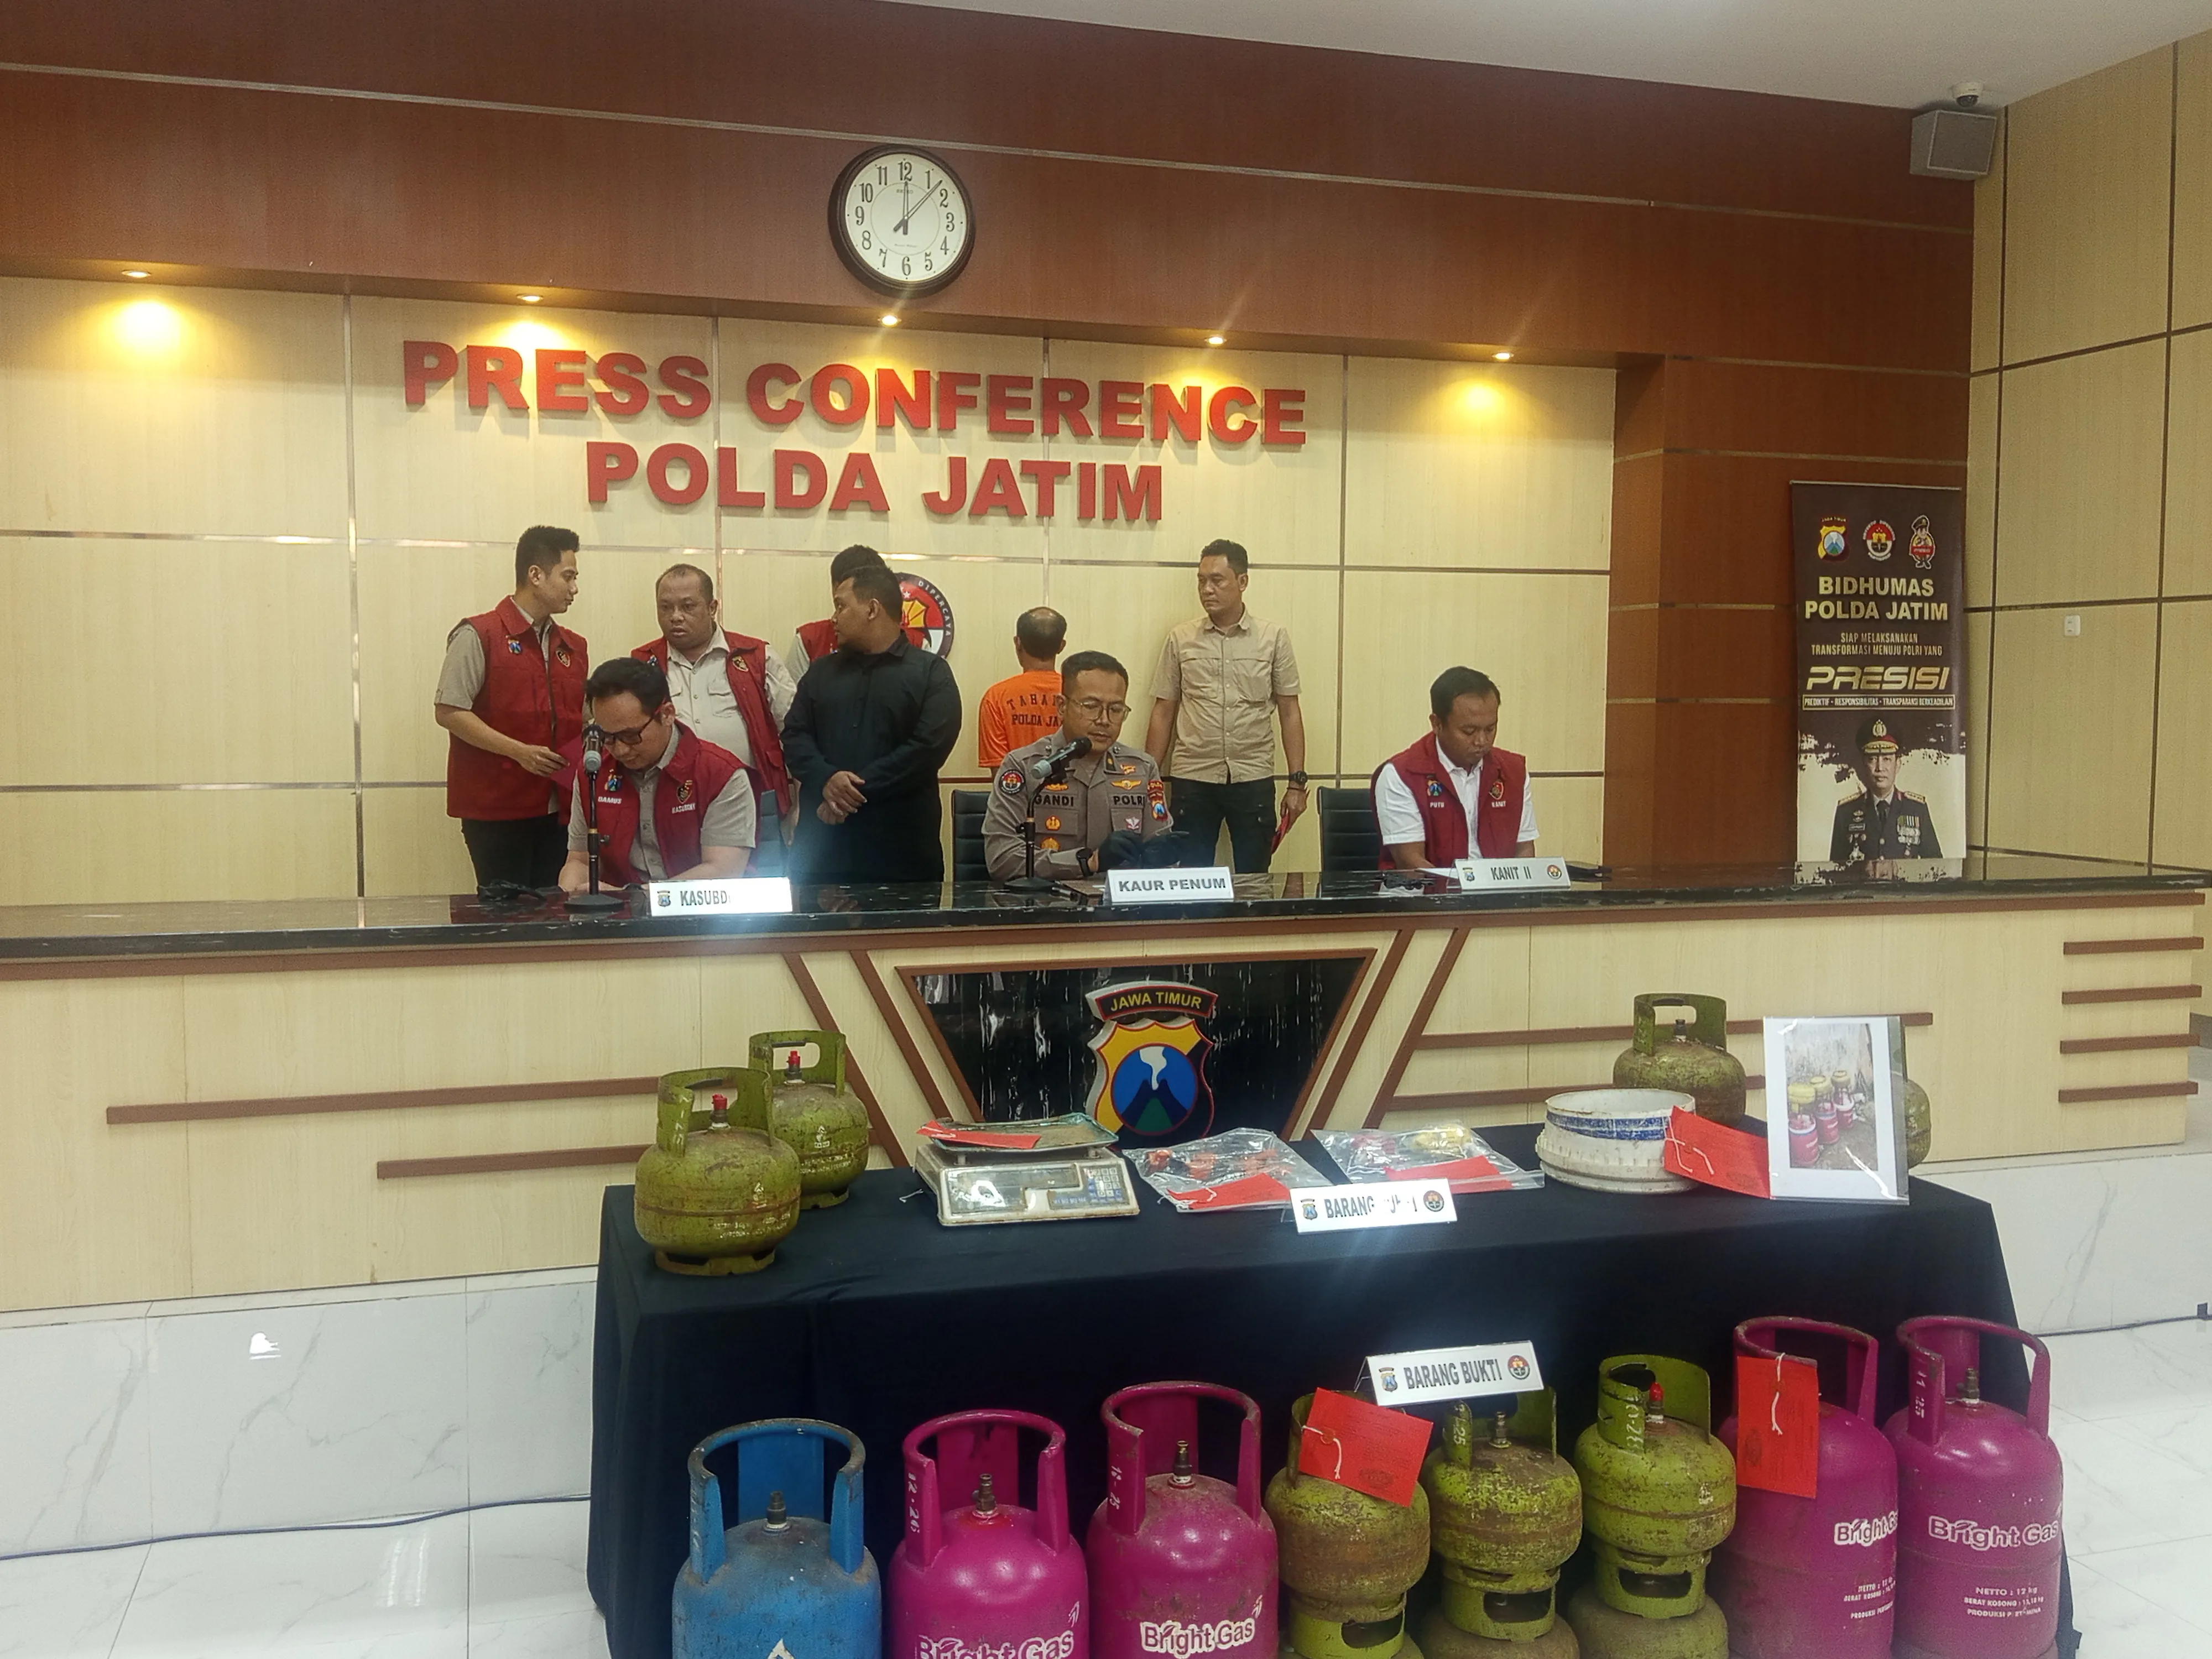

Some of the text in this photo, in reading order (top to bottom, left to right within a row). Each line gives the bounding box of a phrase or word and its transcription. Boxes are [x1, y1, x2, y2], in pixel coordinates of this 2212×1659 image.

[877, 166, 887, 186] 11
[898, 161, 912, 181] 12
[925, 170, 930, 189] 1
[859, 182, 873, 203] 10
[940, 188, 948, 208] 2
[855, 206, 864, 226] 9
[946, 212, 955, 232] 3
[862, 230, 872, 250] 8
[940, 236, 950, 255] 4
[879, 248, 887, 268] 7
[901, 256, 911, 276] 6
[924, 251, 933, 271] 5
[403, 340, 1306, 445] PRESS CONFERENCE
[586, 441, 1162, 521] POLDA JATIM
[1818, 576, 1934, 597] BIDHUMAS
[917, 580, 952, 637] DIPERCAYA
[1804, 600, 1948, 620] POLDA JATIM
[1840, 632, 1918, 644] SIAP MELAKSANAKAN
[1811, 644, 1943, 656] TRANSFORMASI MENUJU POLRI YANG
[1806, 665, 1950, 691] PRESISI
[1804, 697, 1830, 706] PREDIKTIF
[1834, 697, 1879, 706] RESPONSIBILITAS
[1011, 714, 1062, 727] POLDA JA
[597, 796, 622, 805] DAMUS
[1034, 794, 1074, 807] GANDI
[1112, 794, 1145, 807] POLRI
[1490, 865, 1532, 880] KANIT II
[1118, 878, 1227, 892] KAUR PENUM
[1110, 992, 1202, 1012] JAWA TIMUR
[1323, 1196, 1375, 1218] BARANG
[1403, 1358, 1503, 1390] BARANG BUKTI
[1834, 1510, 1898, 1547] Bright Ga
[1929, 1515, 2059, 1551] Bright Gas
[1964, 1597, 1986, 1606] BERAT
[1975, 1587, 2007, 1596] NETTO
[1966, 1608, 2006, 1618] PRODUKSI
[919, 1630, 1074, 1659] Briht Gas
[1141, 1620, 1255, 1658] Bright Gas
